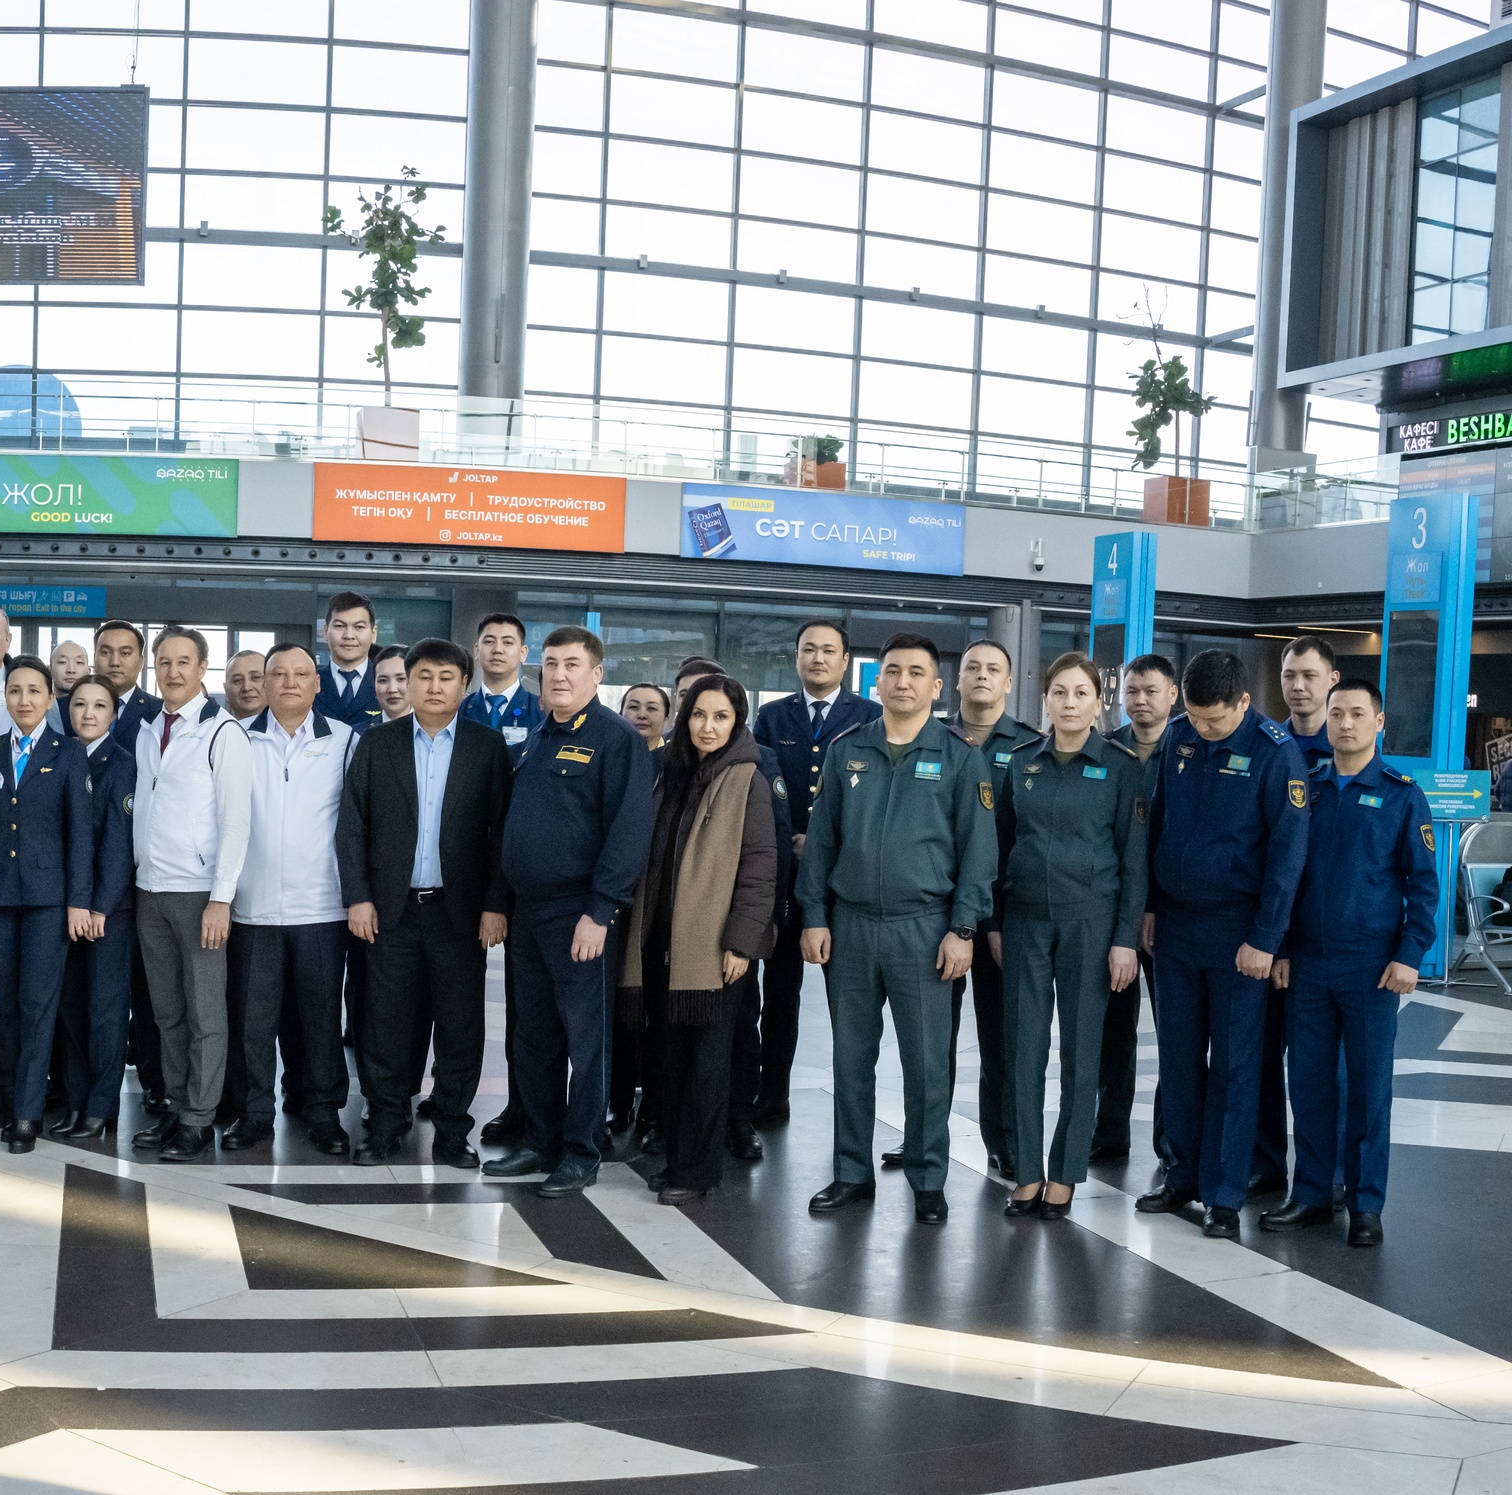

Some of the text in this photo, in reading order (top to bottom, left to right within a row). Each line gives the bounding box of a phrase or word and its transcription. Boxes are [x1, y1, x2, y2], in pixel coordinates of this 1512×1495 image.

[1399, 420, 1438, 439] КАФЕСІ
[1404, 436, 1434, 452] КАФЕ
[156, 468, 228, 479] QAZAQ TILI
[462, 473, 498, 483] JOLTAP
[1, 482, 83, 506] ЖОЛ!
[413, 491, 457, 504] ҚАМТУ
[487, 494, 606, 512] ТРУДОУСТРОЙСТВО
[731, 500, 772, 509] ТІЛАШАР
[30, 511, 113, 524] GOOD LUCK!
[351, 505, 589, 527] ТЕГІН ОҚУ БЕСПЛАТНОЕ ОБУЧЕНИЕ
[696, 508, 722, 521] Oxford
[699, 518, 723, 531] Qazaq
[908, 516, 945, 527] QAZAQ
[1411, 507, 1427, 549] 3
[456, 531, 503, 542] JOLTAP.kz
[754, 518, 898, 547] СӘТ САПАР!
[862, 549, 916, 562] SAFE TRIP!
[1107, 542, 1118, 576] 4
[1405, 557, 1429, 573] Жол
[10, 590, 37, 603] шығу
[8, 604, 32, 612] город
[35, 603, 87, 615] Exit to the city
[532, 625, 541, 641] 6
[1490, 737, 1512, 763] SEC
